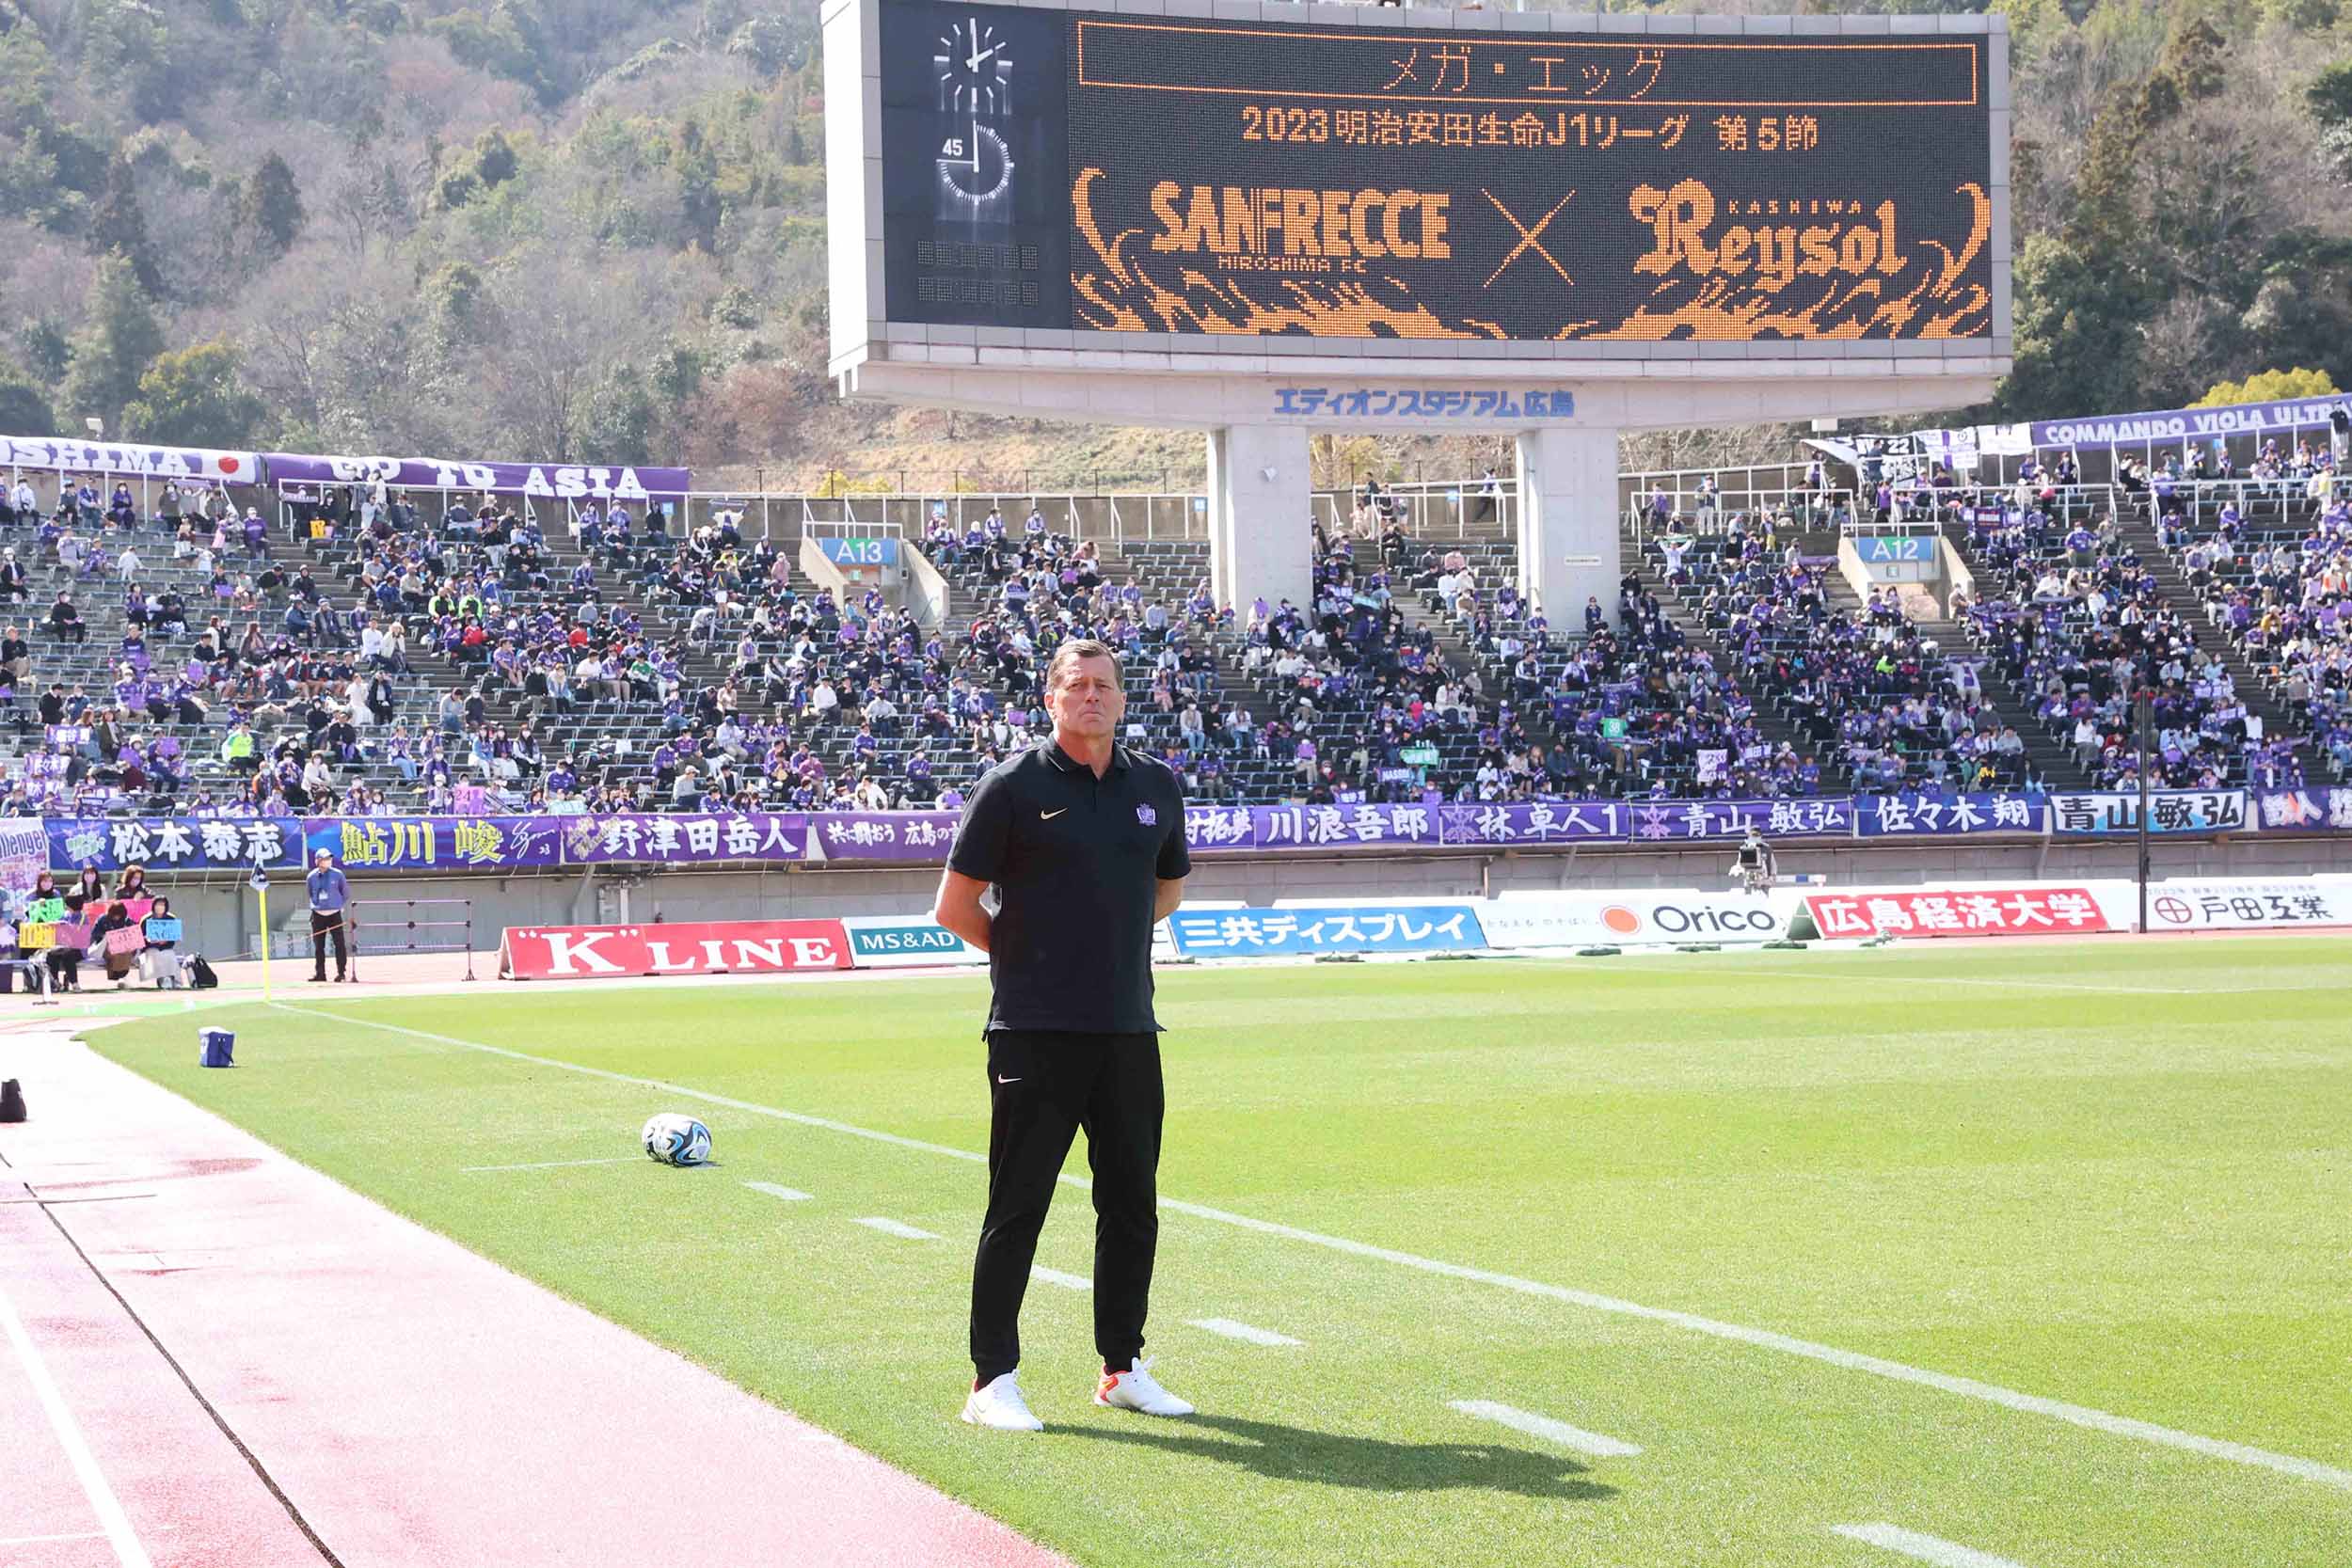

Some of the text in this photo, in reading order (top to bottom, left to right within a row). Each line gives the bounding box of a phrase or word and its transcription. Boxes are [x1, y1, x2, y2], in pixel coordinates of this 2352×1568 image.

[1383, 46, 1663, 99] メガ・エッグ
[942, 138, 963, 158] 45
[1151, 181, 1451, 260] SANFRECCE
[1629, 178, 1908, 291] Reysol
[1218, 255, 1367, 274] HIROSHIMA FC
[1273, 388, 1576, 418] エディオンスタジアム広島
[2045, 417, 2185, 444] COMMANDO
[2194, 408, 2266, 433] VIOLA
[0, 438, 194, 473] SHIMA
[1887, 437, 1910, 454] 22
[524, 467, 647, 499] ASIA
[835, 541, 882, 563] A13
[1870, 539, 1919, 561] A12
[1266, 805, 1430, 845] 川浪吾郎
[1679, 802, 1845, 838] 青山敏弘
[1875, 794, 2030, 832] 佐々木翔
[2059, 796, 2240, 830] 青山敏弘
[109, 820, 283, 864] 松本泰志
[597, 815, 799, 858] 野津田岳人
[1180, 912, 1466, 948] 三共ディスプレイ
[1653, 906, 1775, 933] Orico
[1817, 894, 2097, 932] 広島経済大学
[647, 938, 837, 971] LINE
[861, 931, 956, 949] MS&AD
